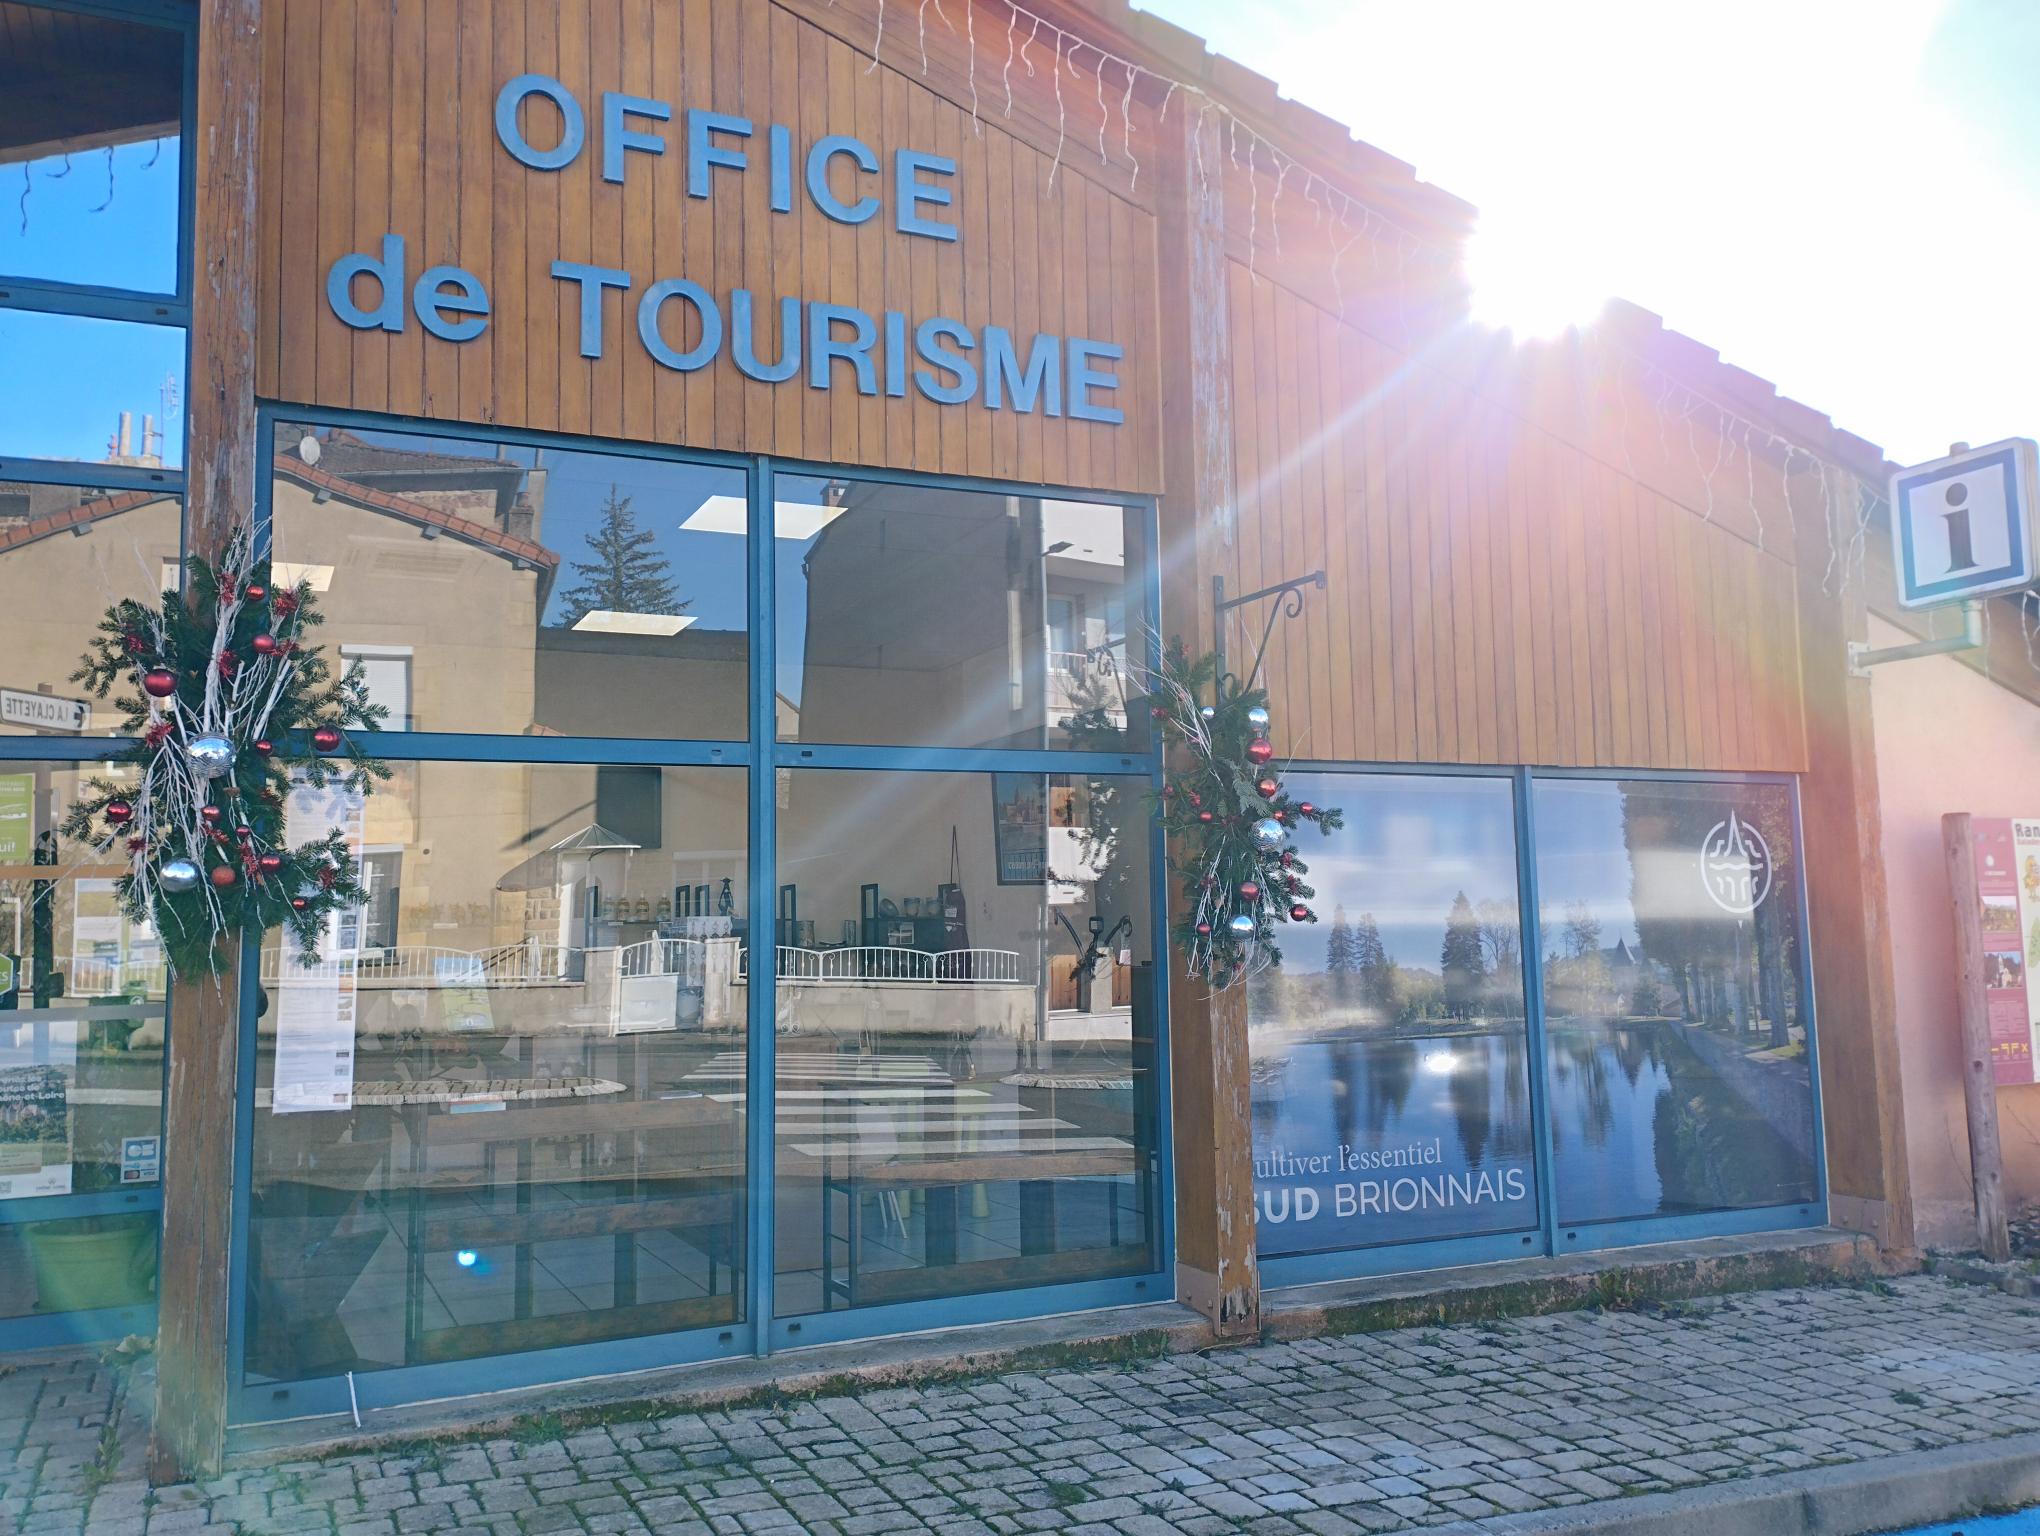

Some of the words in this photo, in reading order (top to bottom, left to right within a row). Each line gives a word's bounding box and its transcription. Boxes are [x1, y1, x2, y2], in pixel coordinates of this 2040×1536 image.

[495, 73, 958, 243] OFFICE
[326, 234, 490, 342] de
[551, 260, 1125, 425] TOURISME
[1252, 1150, 1332, 1179] ultiver
[1338, 1138, 1443, 1172] l'essentiel
[1335, 1168, 1526, 1218] BRIONNAIS
